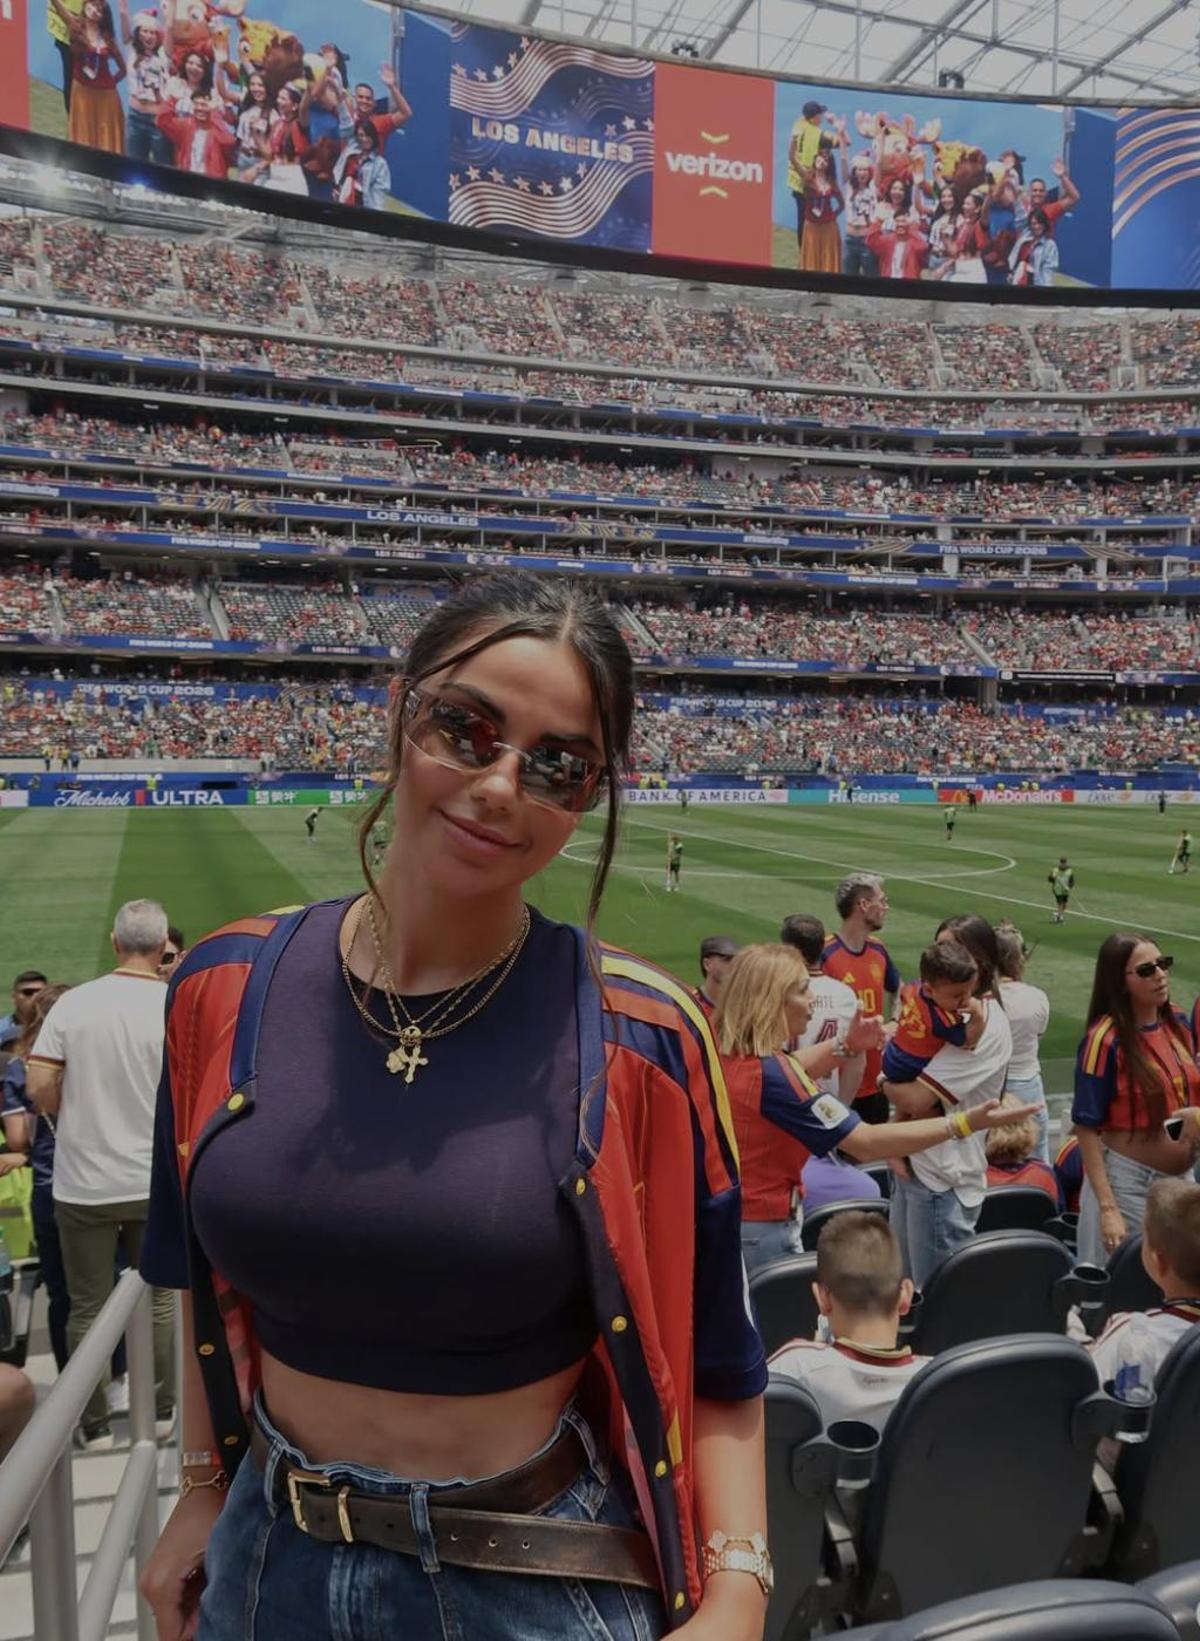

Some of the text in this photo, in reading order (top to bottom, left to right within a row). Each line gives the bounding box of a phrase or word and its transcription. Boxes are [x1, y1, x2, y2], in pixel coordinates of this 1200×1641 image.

[471, 117, 634, 164] LOS ANGELES
[664, 150, 763, 184] verizon
[366, 510, 479, 527] LOS ANGELES
[53, 788, 131, 807] Michelob
[152, 789, 224, 805] ULTRA
[628, 791, 673, 802] BANK
[699, 791, 767, 802] AMERICA
